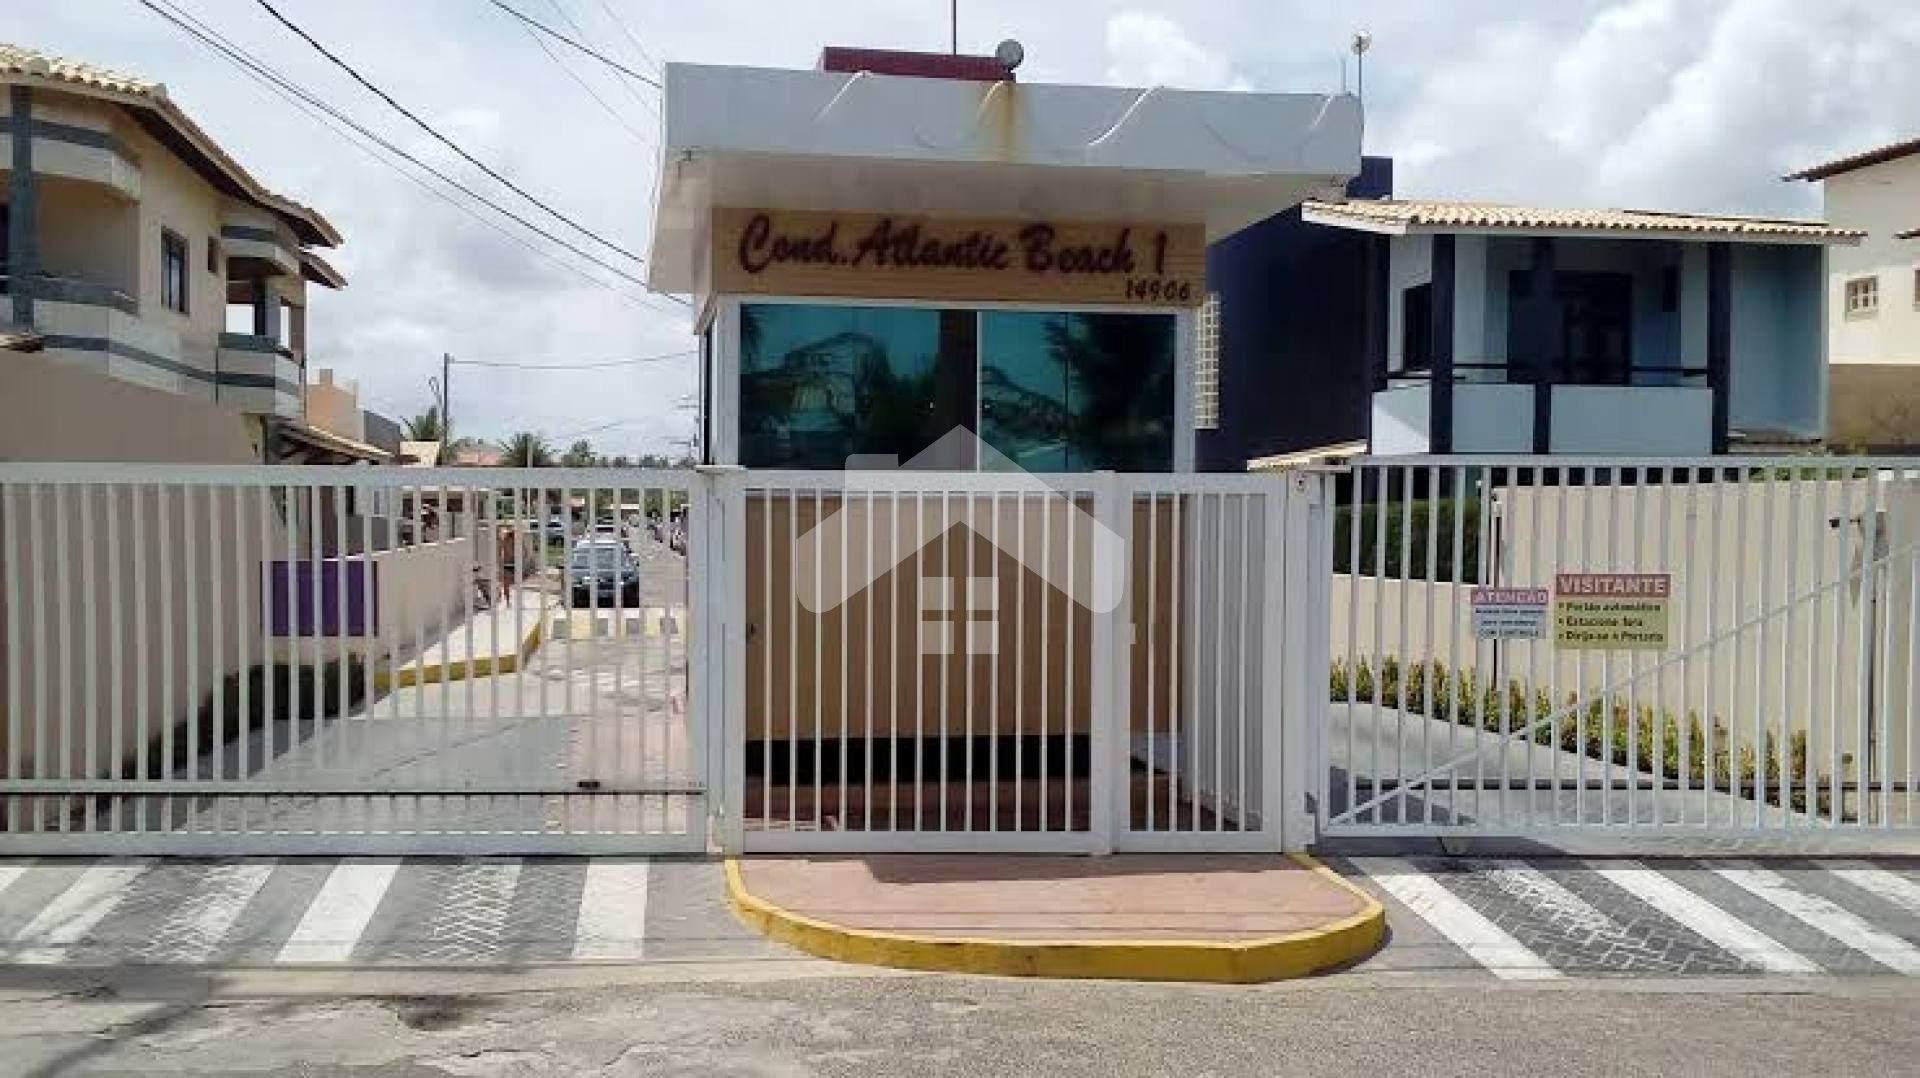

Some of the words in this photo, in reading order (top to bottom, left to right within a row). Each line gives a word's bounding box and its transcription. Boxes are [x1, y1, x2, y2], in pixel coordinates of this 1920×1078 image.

[739, 214, 847, 274] Cond.
[852, 217, 1010, 269] Atlantic
[1020, 223, 1136, 275] Beach
[1125, 279, 1191, 302] 14906
[1558, 576, 1666, 593] VISITANTE
[1566, 616, 1618, 627] Estacione
